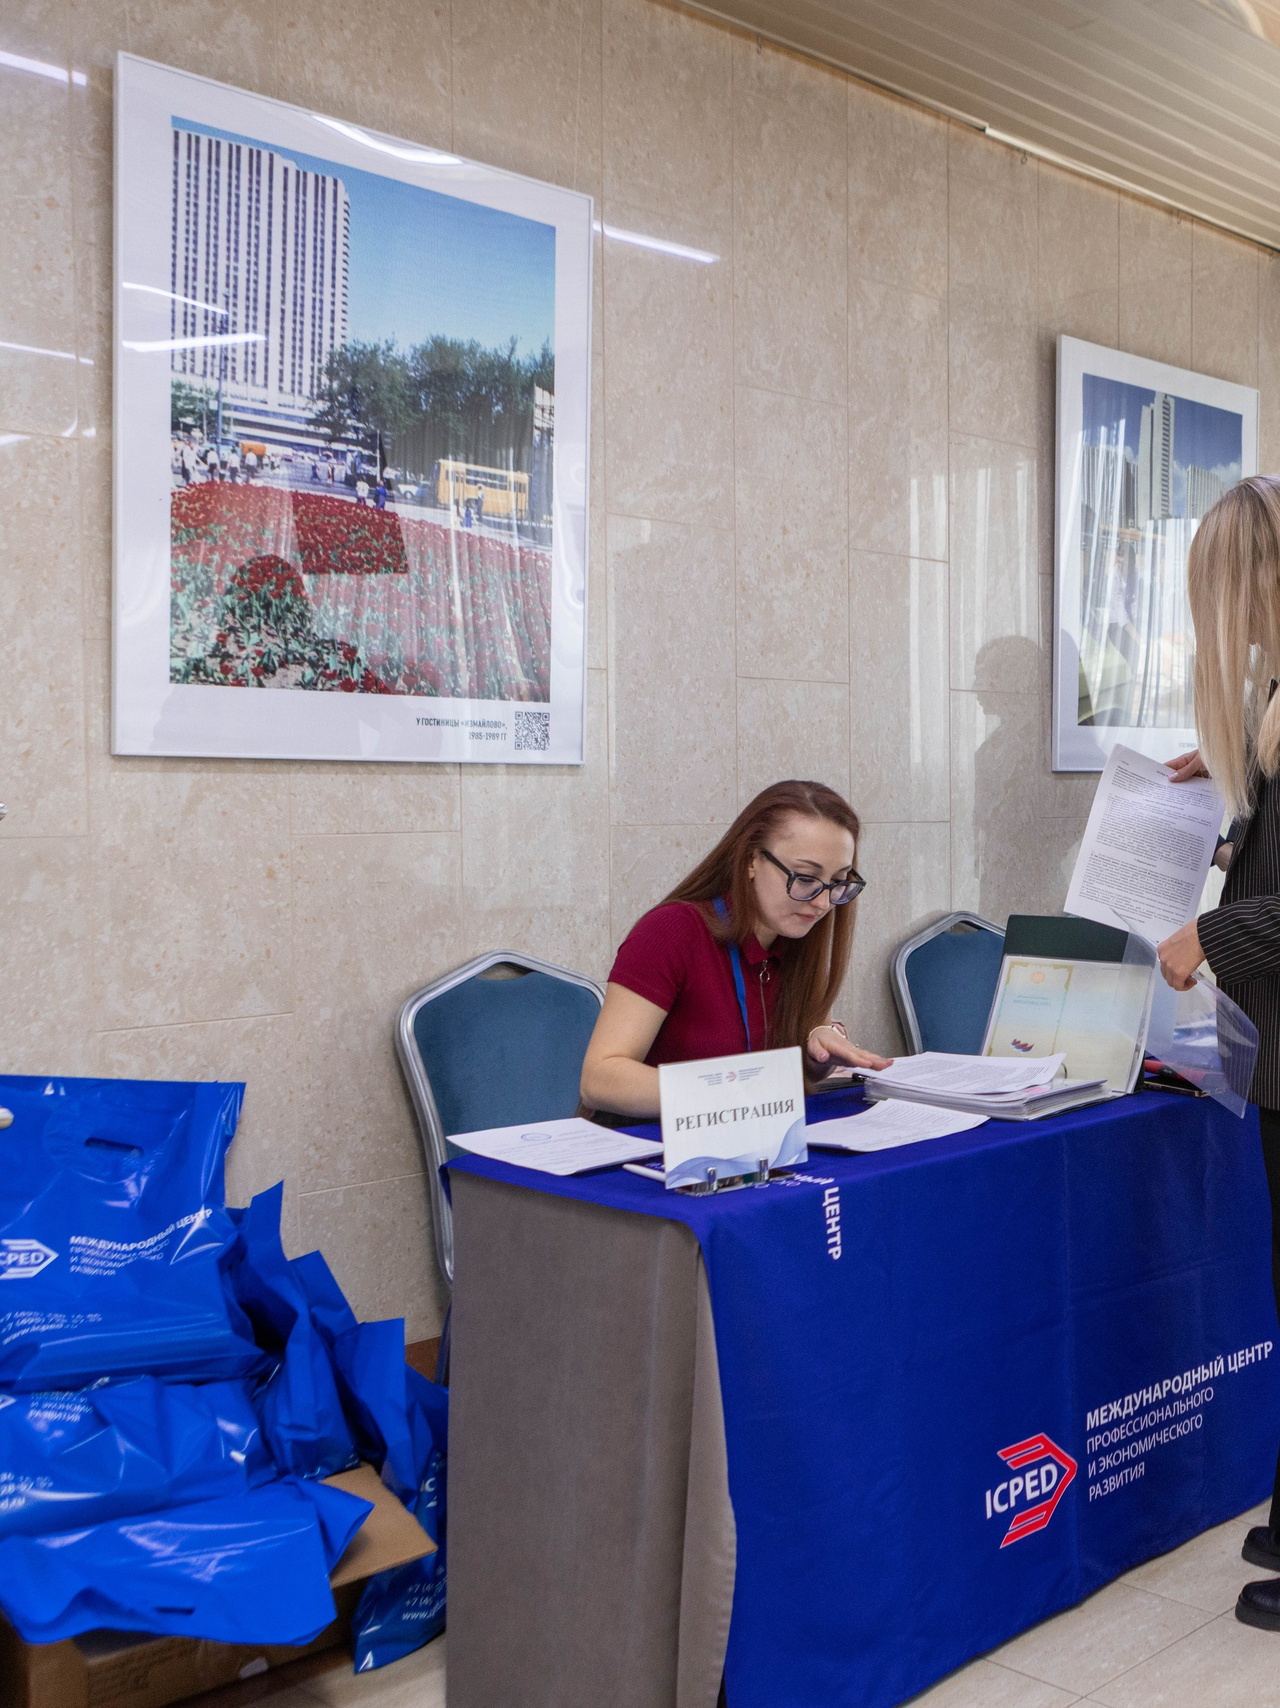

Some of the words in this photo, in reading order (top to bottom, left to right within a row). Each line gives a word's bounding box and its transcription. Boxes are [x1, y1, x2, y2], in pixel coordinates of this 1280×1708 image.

[416, 718, 421, 726] У
[421, 718, 459, 728] ГОСТИНИЦЫ
[675, 1099, 795, 1132] РЕГИСТРАЦИЯ
[70, 1224, 175, 1252] МЕЖДУНАРОДНЫЙ
[822, 1187, 842, 1260] ЦЕНТР
[0, 1251, 45, 1265] CPED
[1086, 1355, 1225, 1431] МЕЖДУНАРОДНЫЙ
[1228, 1341, 1273, 1373] ЦЕНТР
[1087, 1386, 1214, 1455] ПРОФЕССИОНАЛЬНОГО
[1088, 1462, 1096, 1478] И
[1098, 1414, 1203, 1473] ЭКОНОМИЧЕСКОГО
[985, 1463, 1058, 1520] ICPED
[1089, 1461, 1145, 1502] РАЗВИТИЯ
